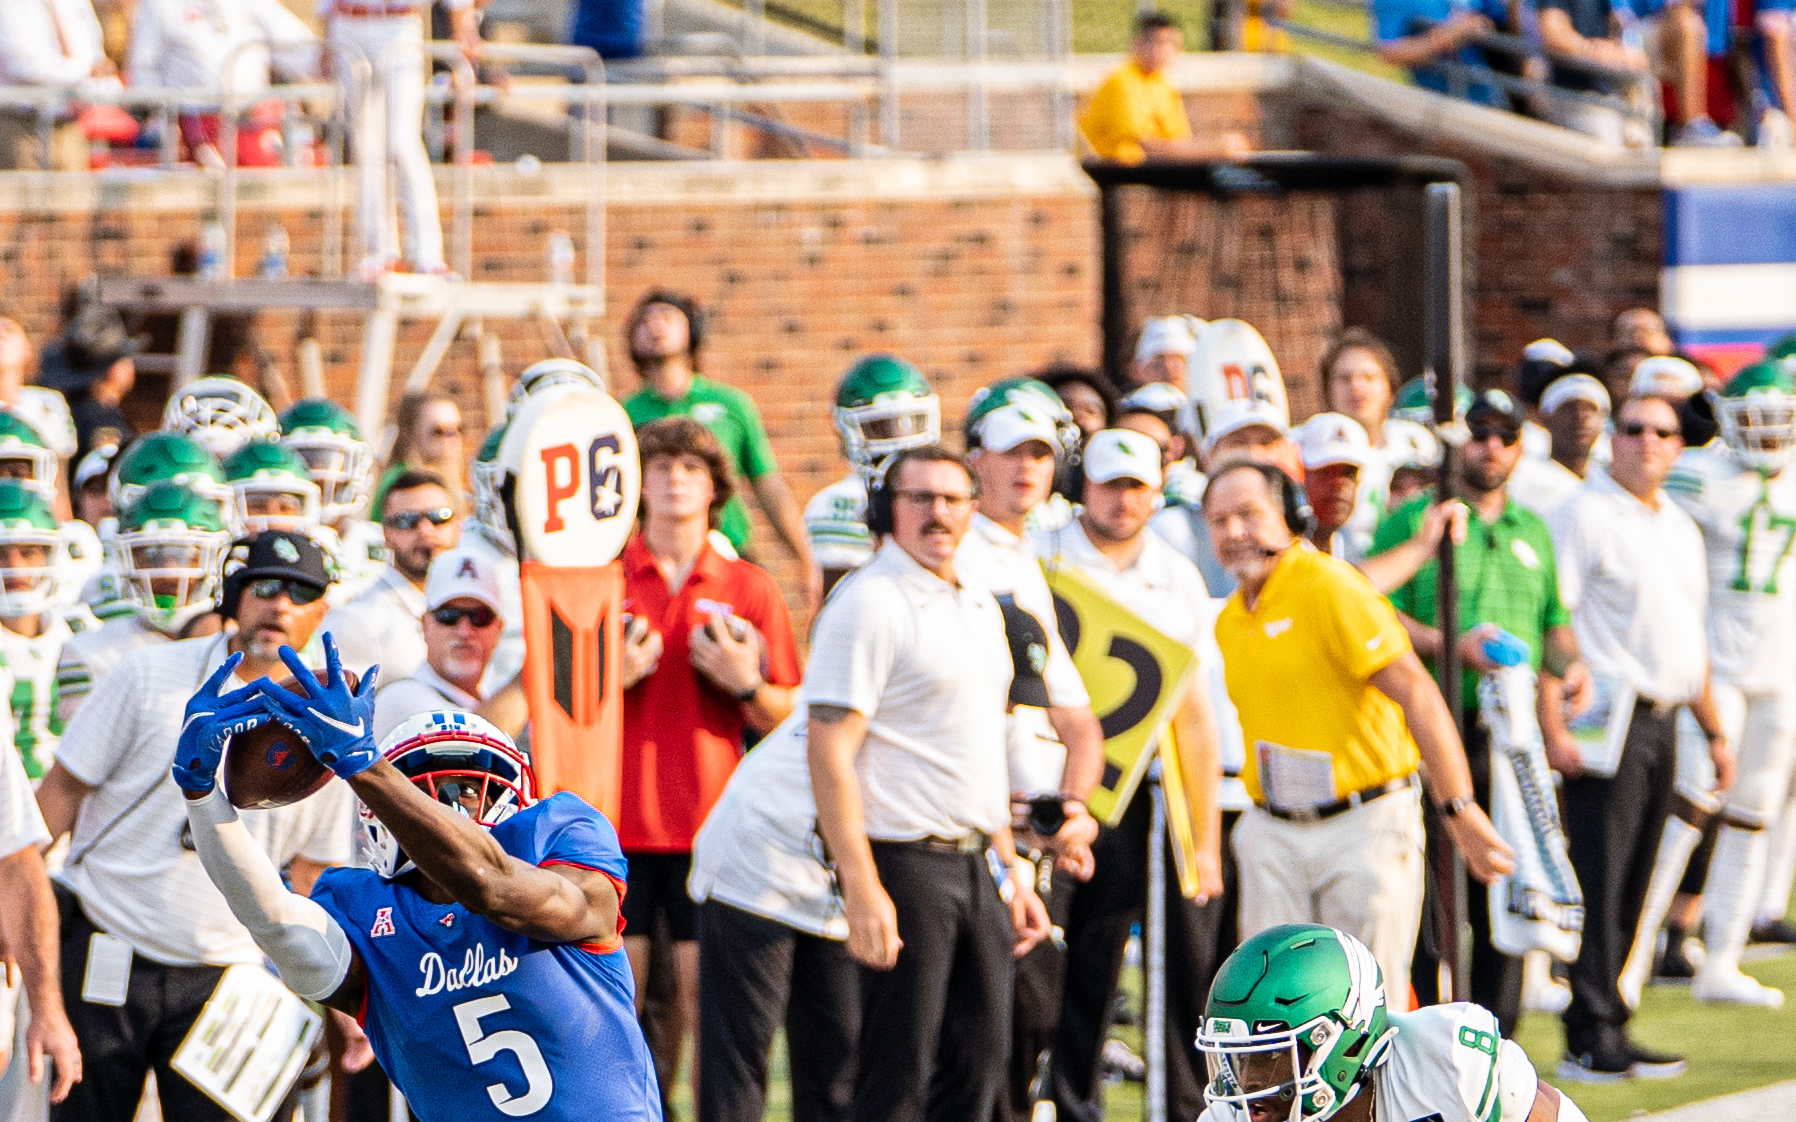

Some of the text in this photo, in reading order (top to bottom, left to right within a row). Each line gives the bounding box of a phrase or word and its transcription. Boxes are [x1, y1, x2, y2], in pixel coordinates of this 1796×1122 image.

[540, 435, 623, 533] P6
[457, 557, 478, 578] A
[415, 942, 519, 998] Dallas
[452, 993, 553, 1117] 5
[1458, 1025, 1497, 1056] 8
